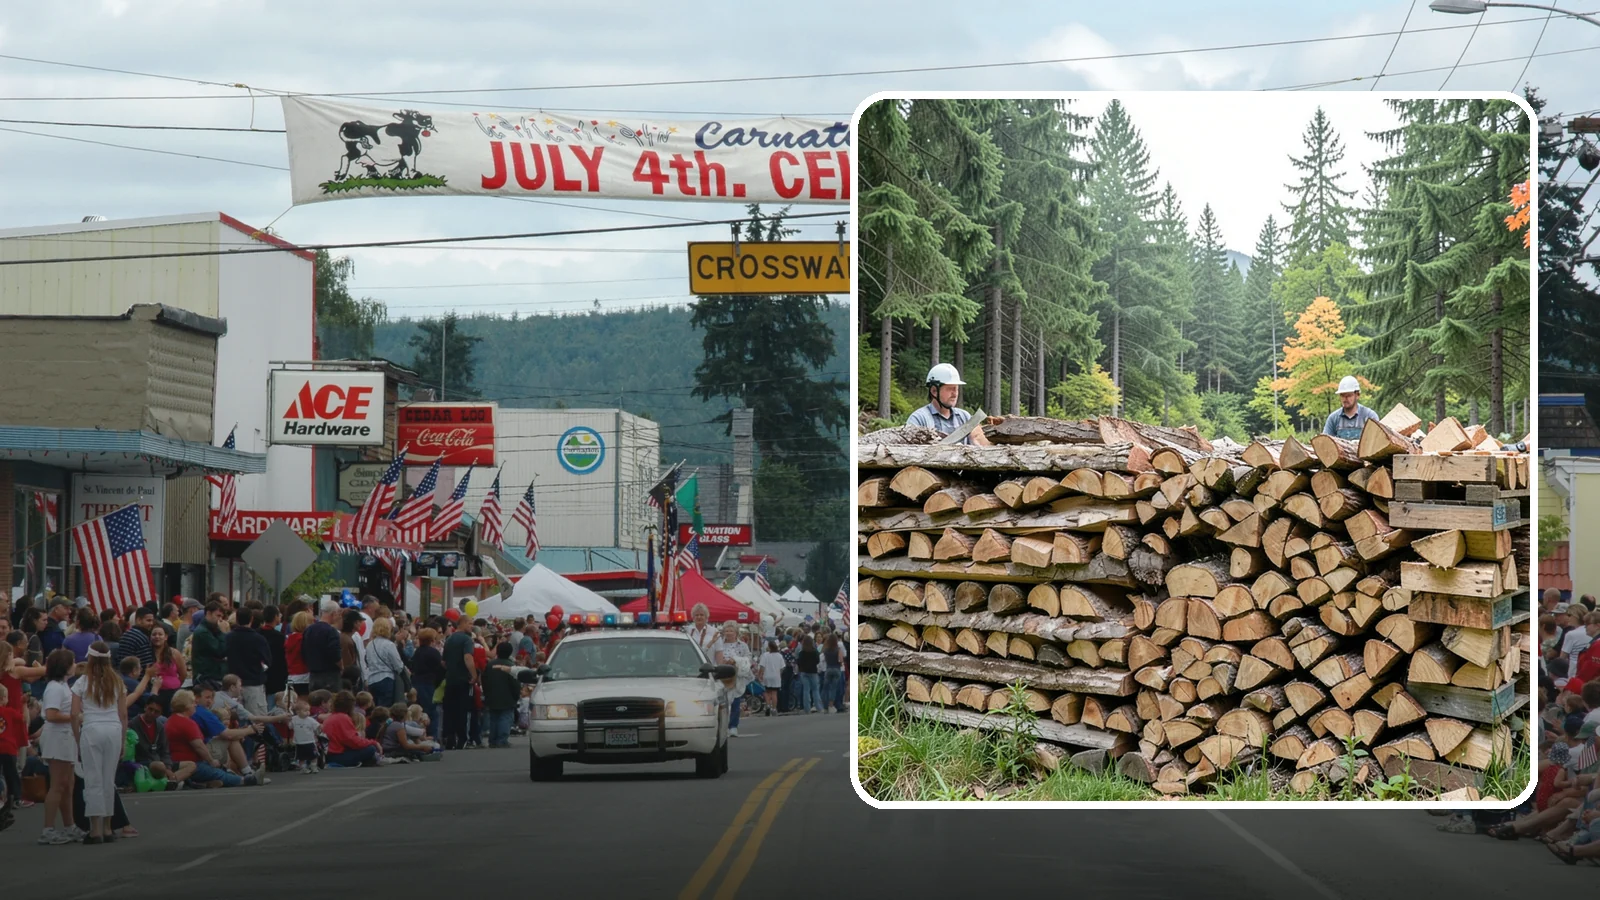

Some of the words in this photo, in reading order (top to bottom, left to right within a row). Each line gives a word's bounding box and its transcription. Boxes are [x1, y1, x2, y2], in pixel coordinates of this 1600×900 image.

[481, 141, 605, 192] JULY
[632, 150, 746, 198] 4th.
[697, 254, 850, 279] CROSSWA
[283, 380, 373, 420] ACE
[405, 409, 452, 422] CEDAR
[284, 421, 370, 436] Hardware
[353, 467, 385, 480] Simpl
[96, 485, 124, 495] Vincent
[126, 486, 136, 495] de
[138, 486, 155, 495] Paul
[688, 526, 741, 535] CRNATION
[699, 535, 730, 543] GLASS
